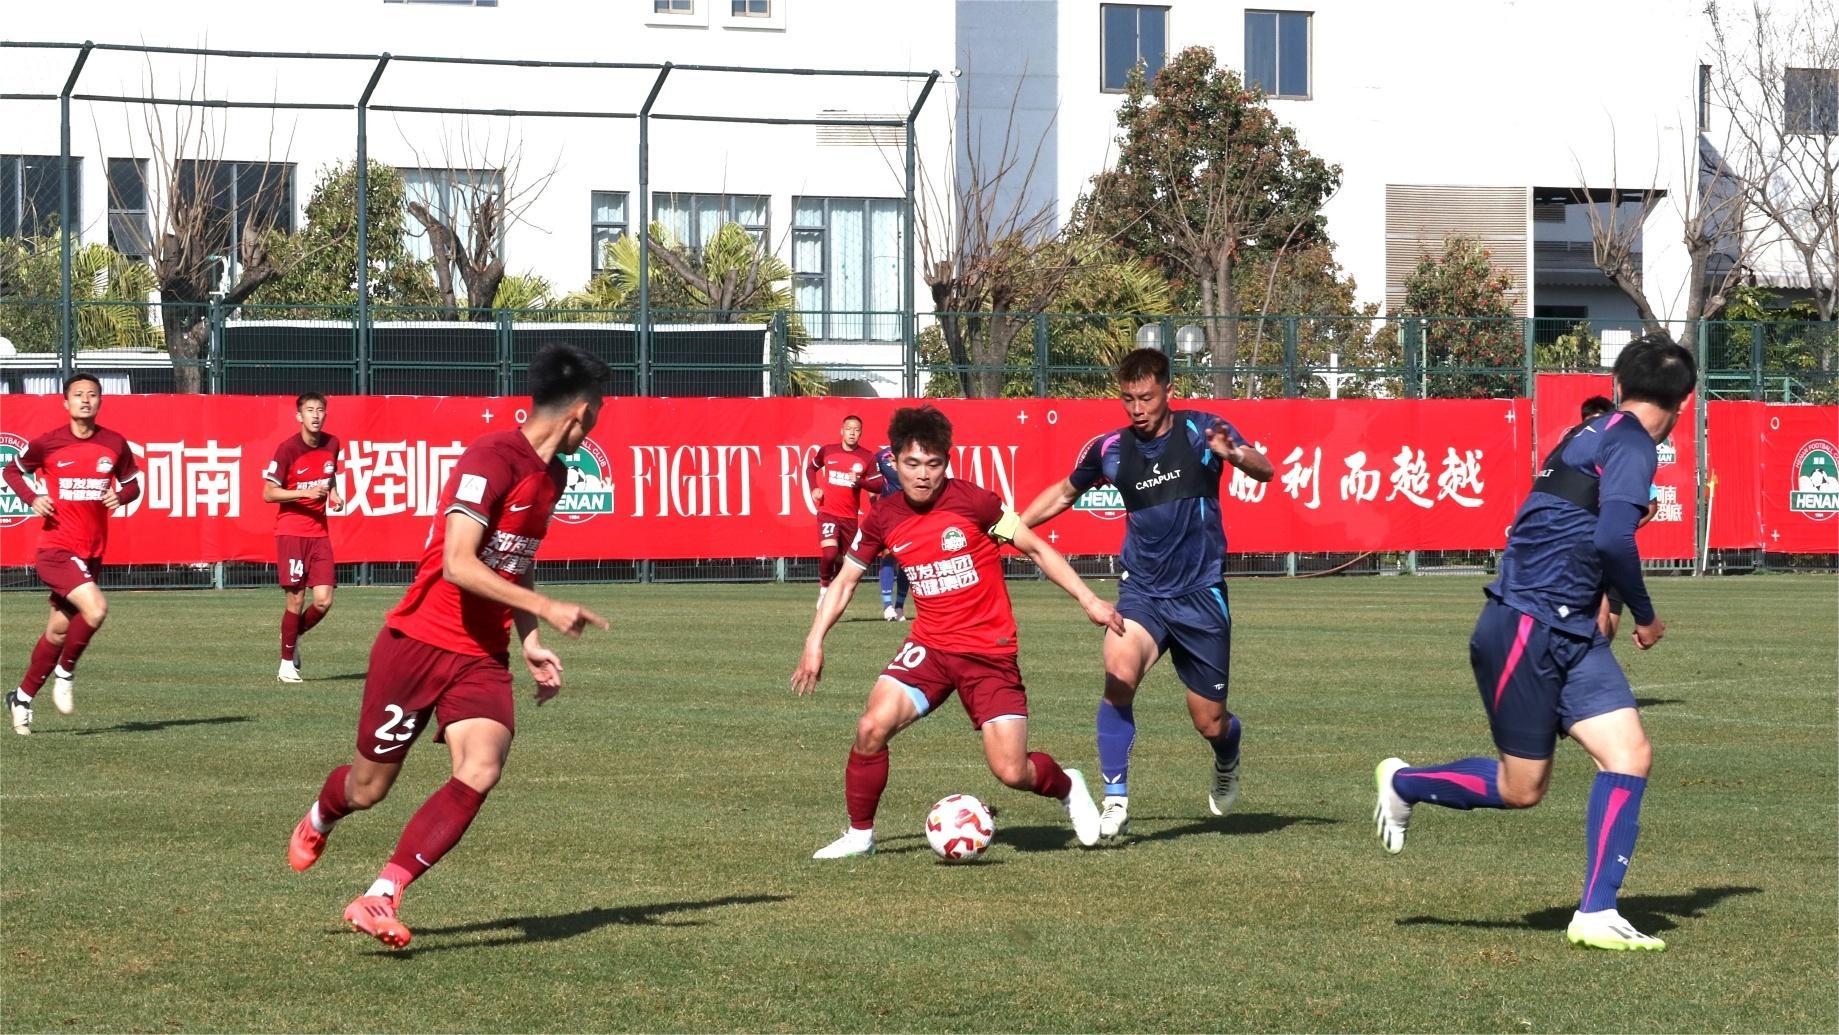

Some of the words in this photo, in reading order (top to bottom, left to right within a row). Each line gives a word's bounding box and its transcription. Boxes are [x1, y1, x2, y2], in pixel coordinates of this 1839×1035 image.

[629, 445, 761, 517] FIGHT
[1136, 470, 1181, 490] CATAPULT
[555, 494, 605, 510] ENAN
[1081, 491, 1125, 507] HENA
[1797, 494, 1839, 508] HENAN
[822, 522, 836, 535] 27
[289, 559, 304, 577] 14
